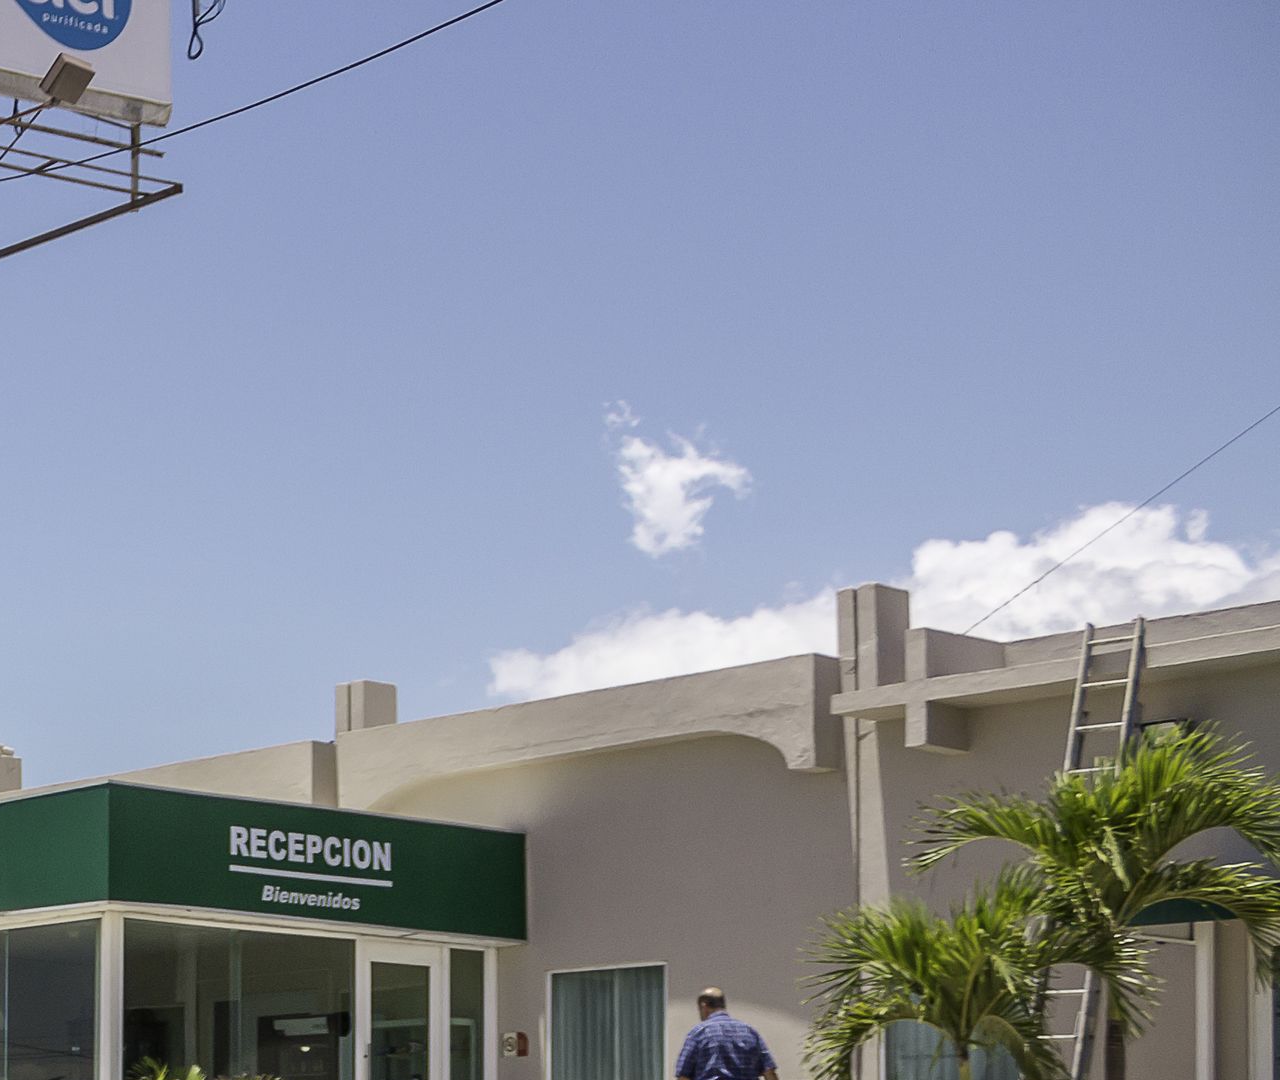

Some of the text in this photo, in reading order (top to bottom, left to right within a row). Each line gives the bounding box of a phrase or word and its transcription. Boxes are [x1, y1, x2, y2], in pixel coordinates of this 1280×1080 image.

[42, 12, 109, 34] purificada
[230, 825, 392, 871] RECEPCION
[261, 884, 361, 910] Bienvenidos
